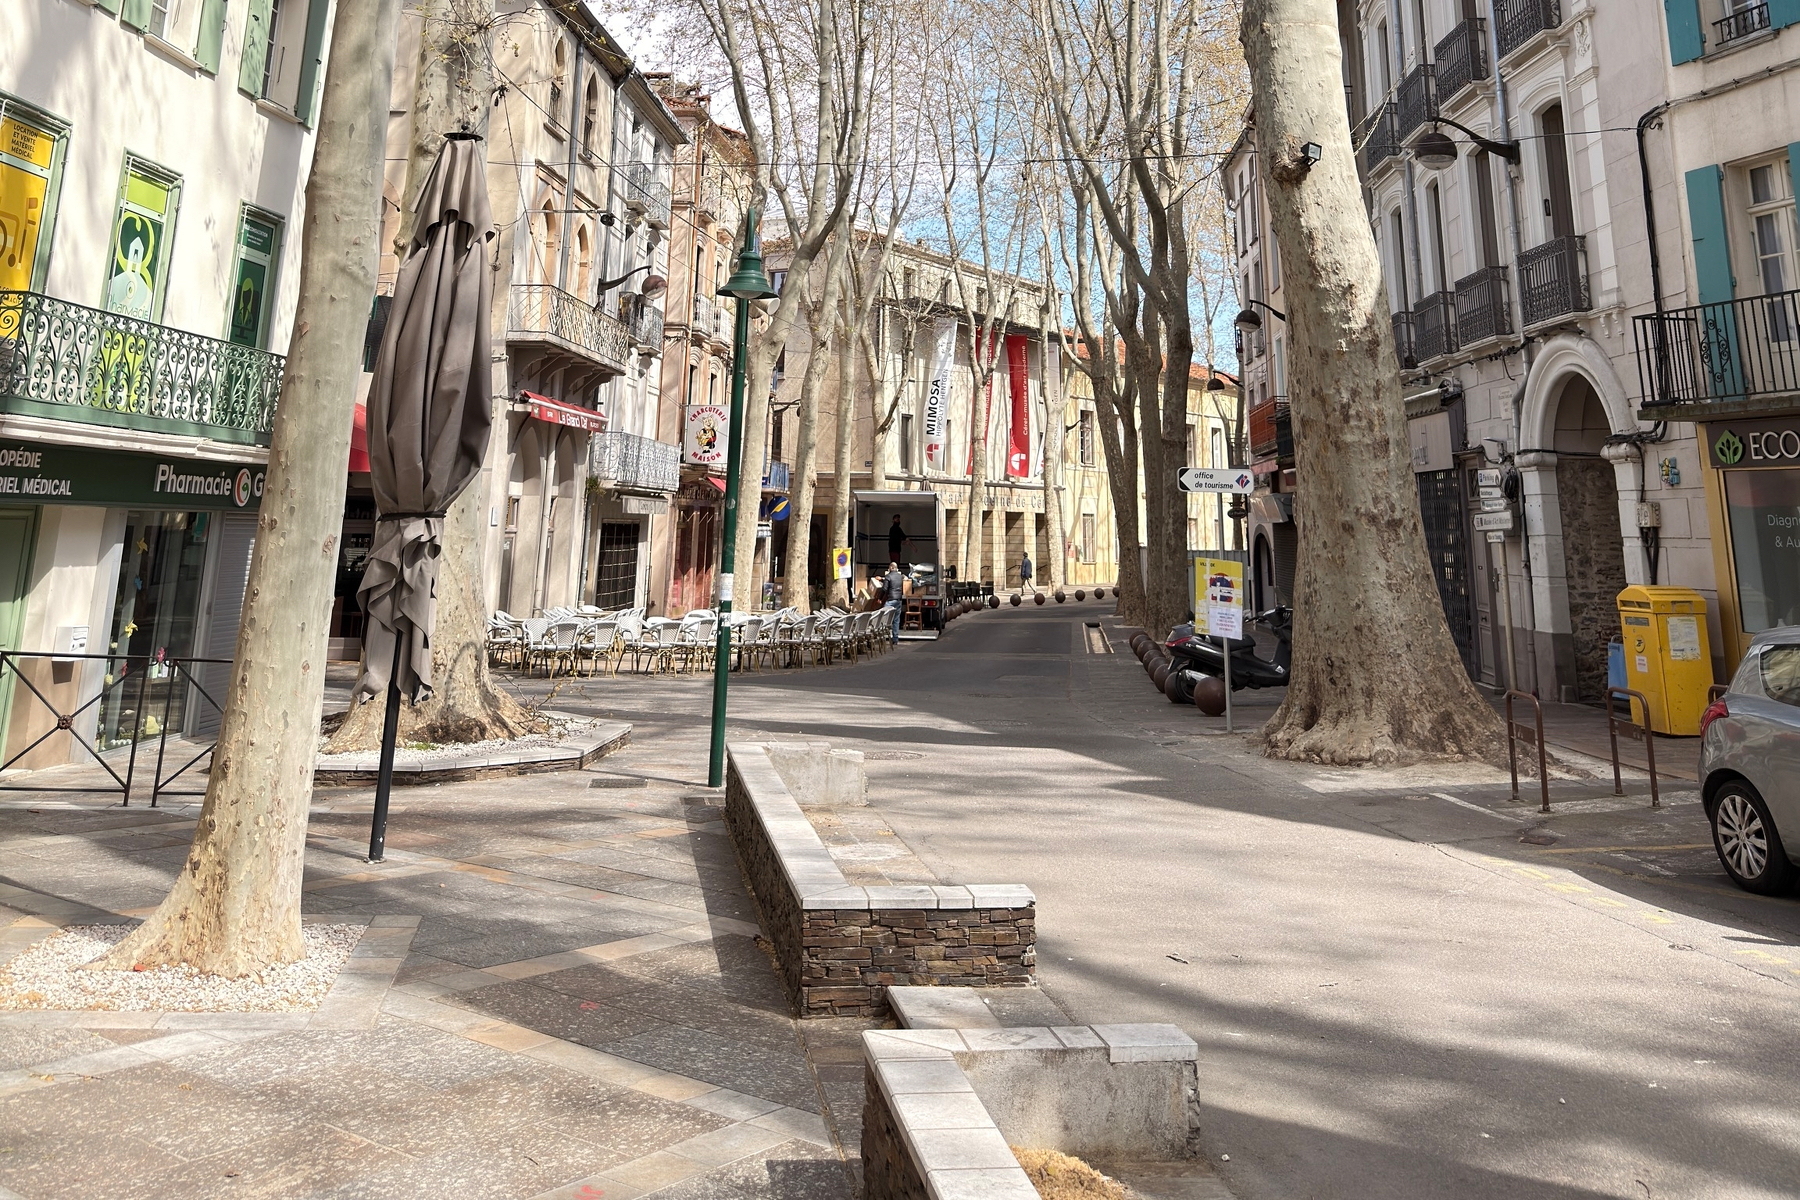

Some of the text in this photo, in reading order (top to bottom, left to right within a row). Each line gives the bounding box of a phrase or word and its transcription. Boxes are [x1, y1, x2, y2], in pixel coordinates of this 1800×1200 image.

[13, 124, 38, 138] LOCATION
[20, 133, 36, 145] VENTE
[940, 368, 949, 400] HENTGEN
[690, 407, 727, 422] CHARCUTERIE
[926, 379, 941, 436] MIMOSA
[936, 402, 945, 436] HIPPOLYTE
[691, 451, 721, 462] MAISON
[22, 473, 72, 496] MÉDICAL
[154, 464, 232, 496] Pharmacie
[1767, 514, 1800, 529] Diagn
[1775, 536, 1783, 548] &
